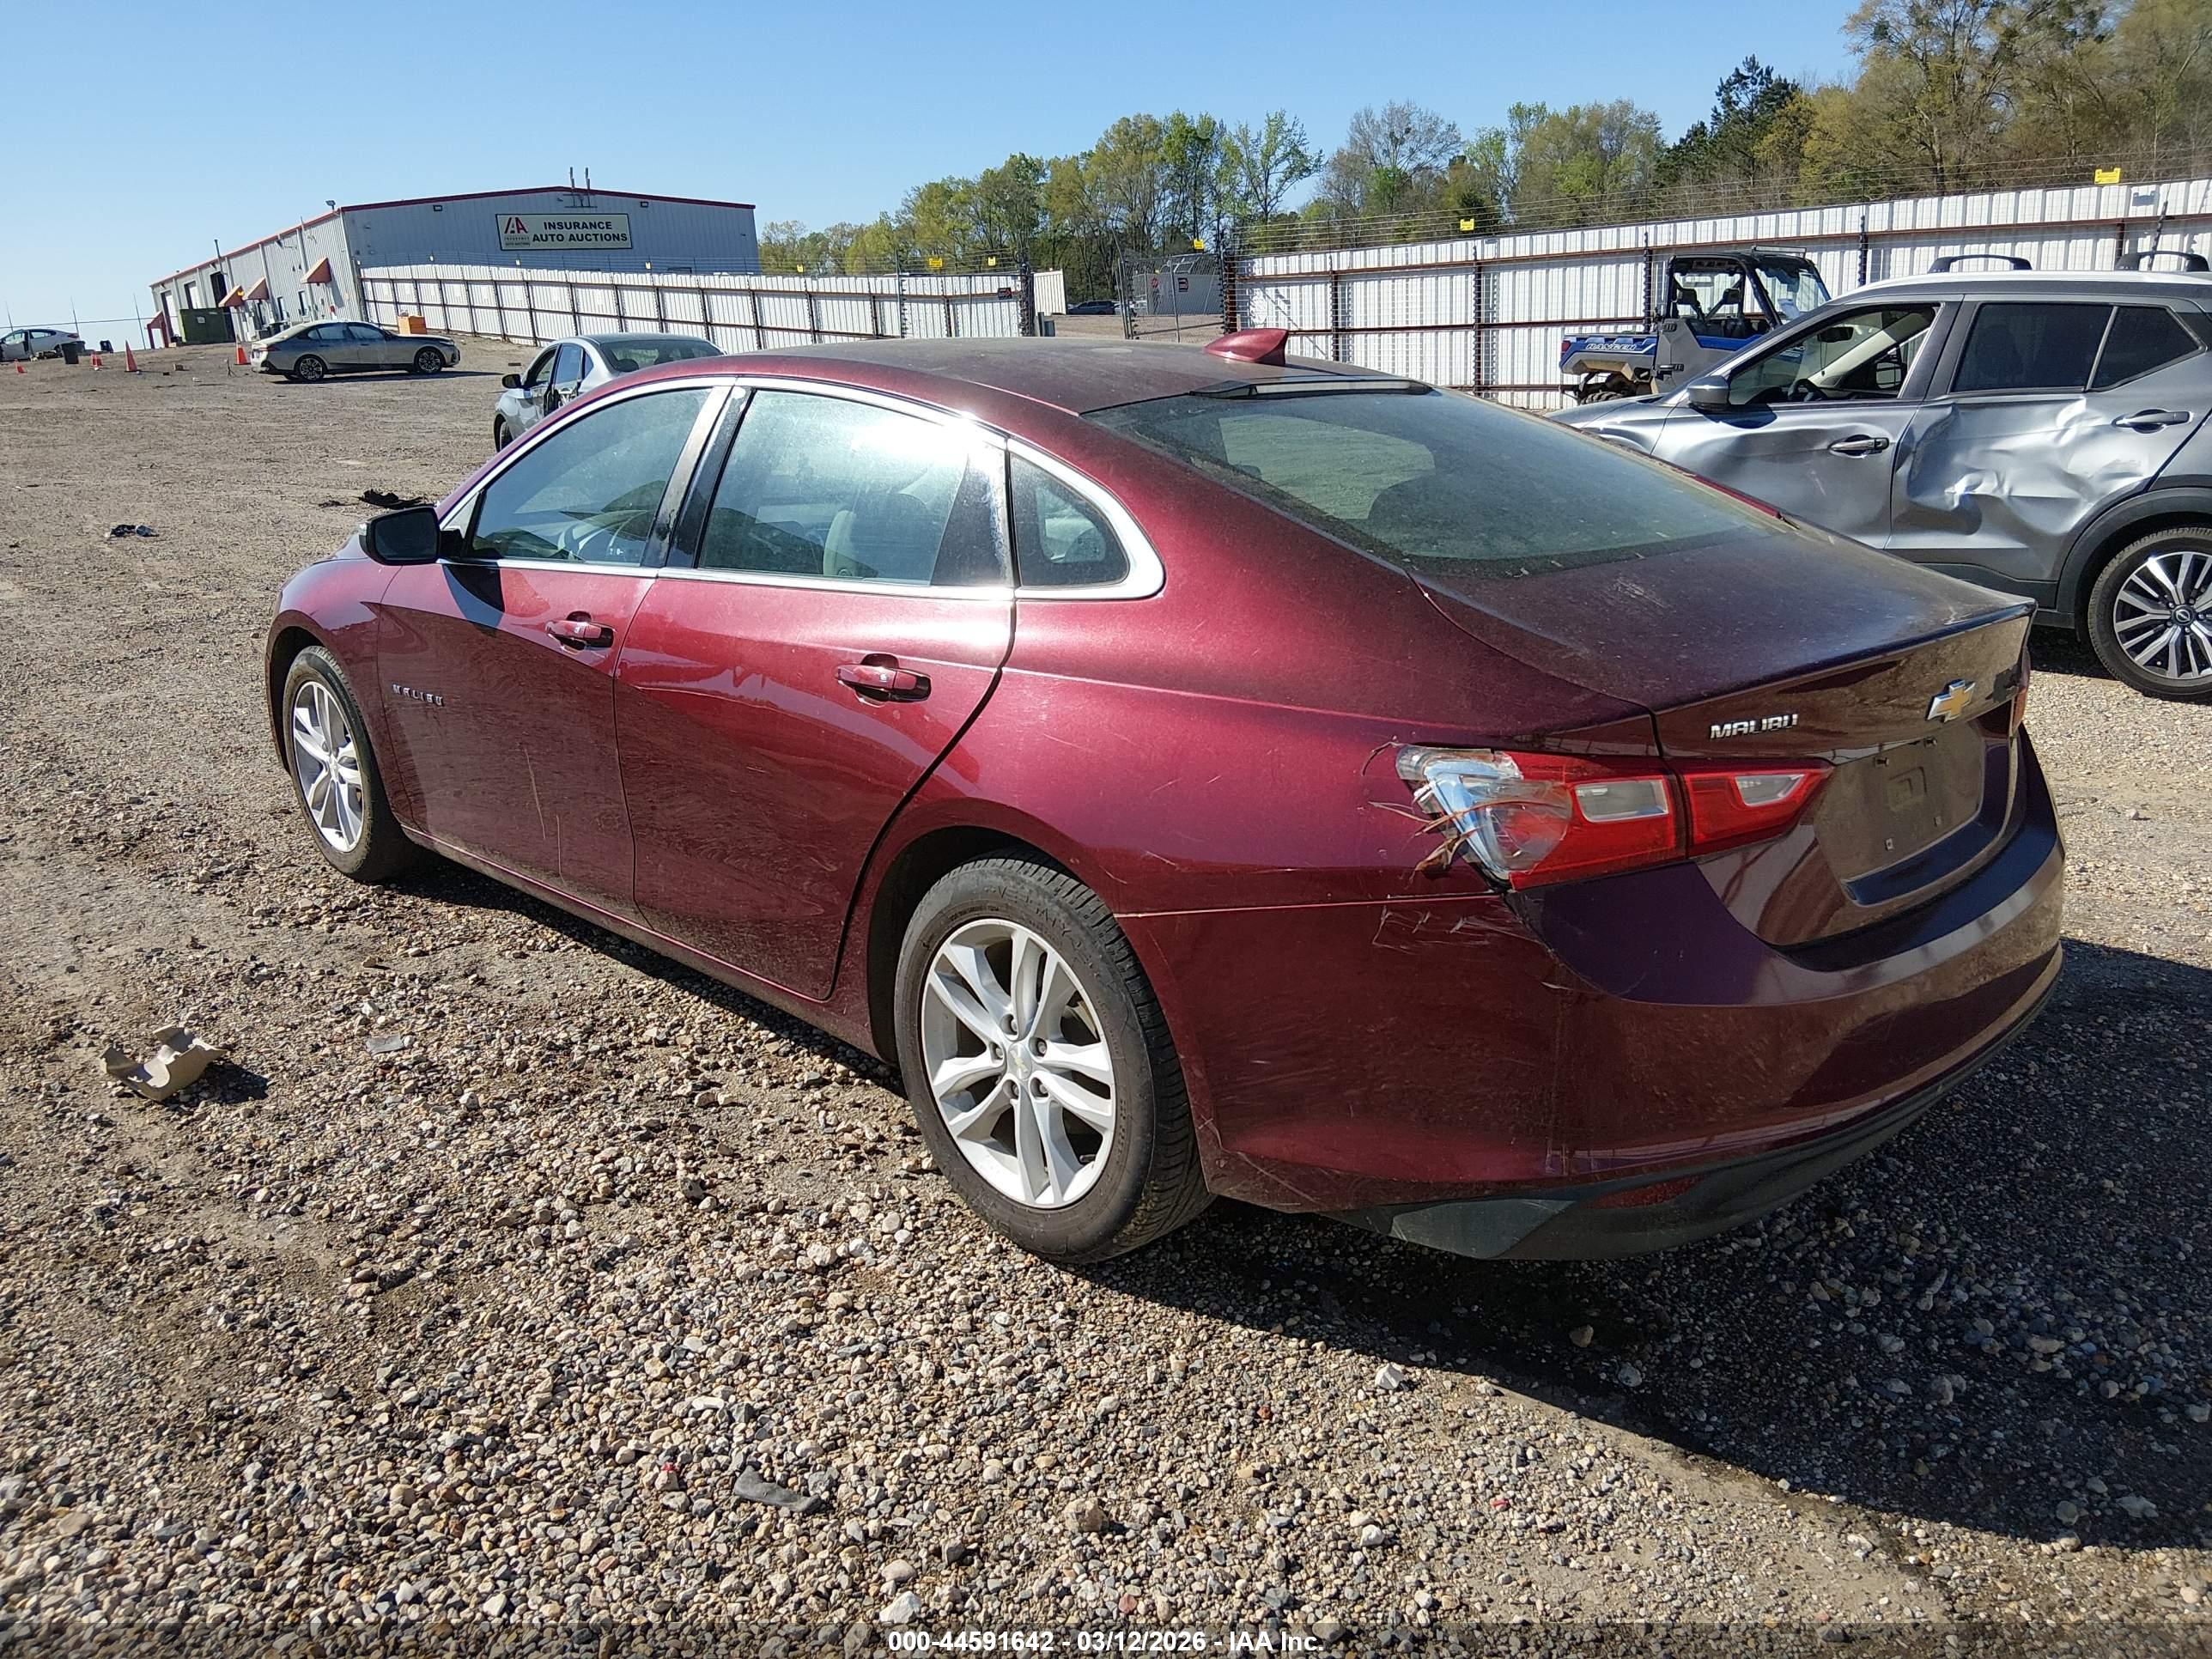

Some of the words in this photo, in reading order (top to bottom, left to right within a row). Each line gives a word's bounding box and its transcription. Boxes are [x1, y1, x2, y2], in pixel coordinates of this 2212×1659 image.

[544, 222, 612, 230] INSURANCE
[532, 234, 564, 242] AUTO
[568, 234, 628, 242] AUCTIONS
[392, 684, 444, 706] MALIBU
[1710, 714, 1798, 739] MALIBU
